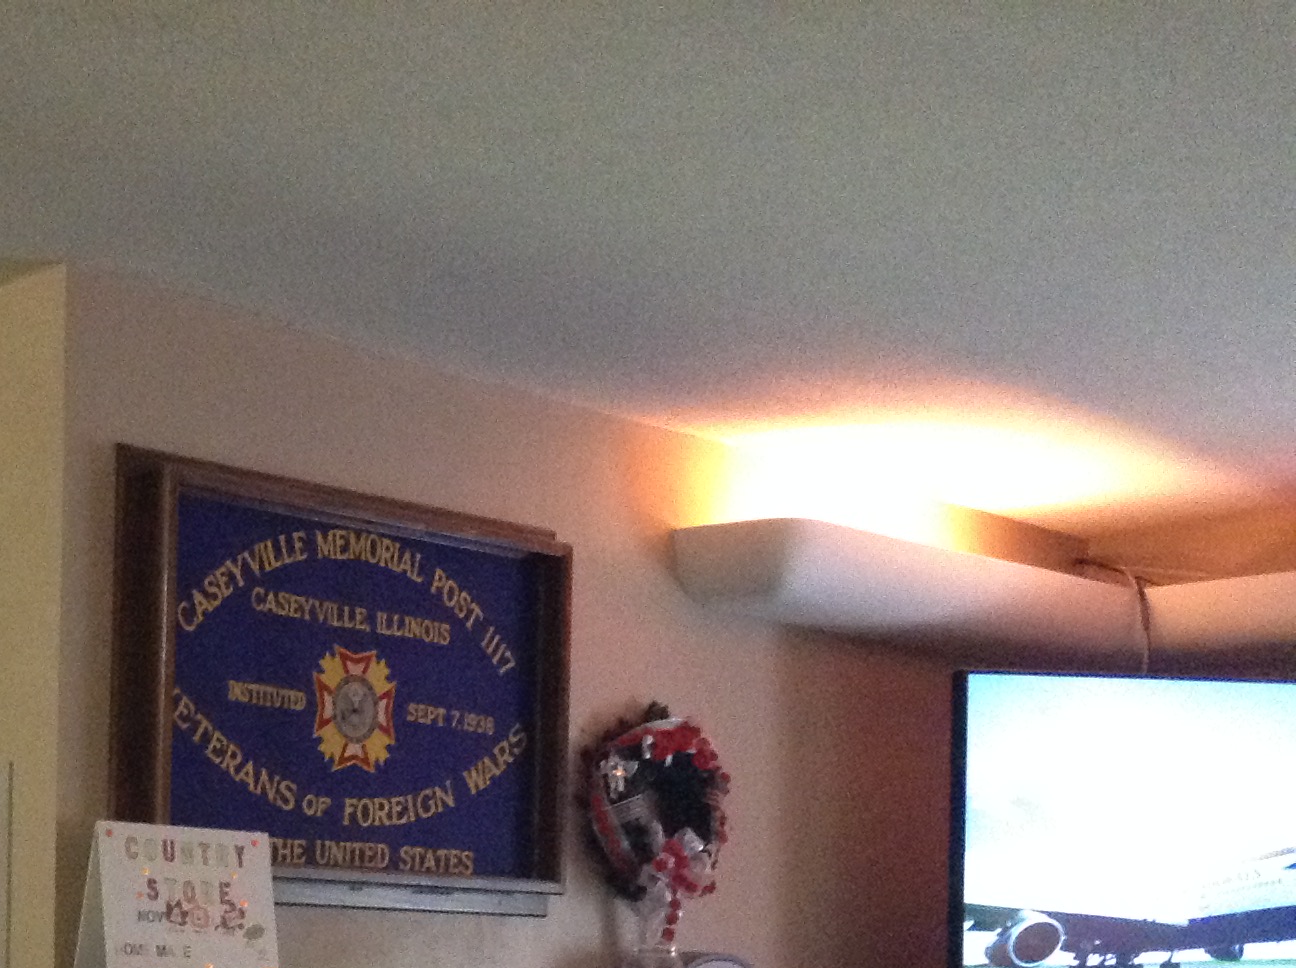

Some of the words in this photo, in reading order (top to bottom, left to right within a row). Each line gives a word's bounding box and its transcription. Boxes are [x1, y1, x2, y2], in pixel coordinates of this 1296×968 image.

[176, 530, 308, 632] CASEYVILLE
[315, 529, 424, 583] MEMORIAL
[430, 567, 485, 631] POST
[480, 625, 516, 676] 1117
[375, 611, 452, 646] ILLINOIS
[227, 679, 306, 712] INSTITUTED
[406, 703, 447, 727] SEPT
[301, 793, 333, 818] OF
[342, 779, 457, 827] FOREIGN
[461, 722, 528, 795] WARS
[124, 836, 246, 869] COUNTRY
[314, 840, 390, 869] UNITED
[399, 846, 475, 876] STATES
[146, 877, 231, 905] STORE
